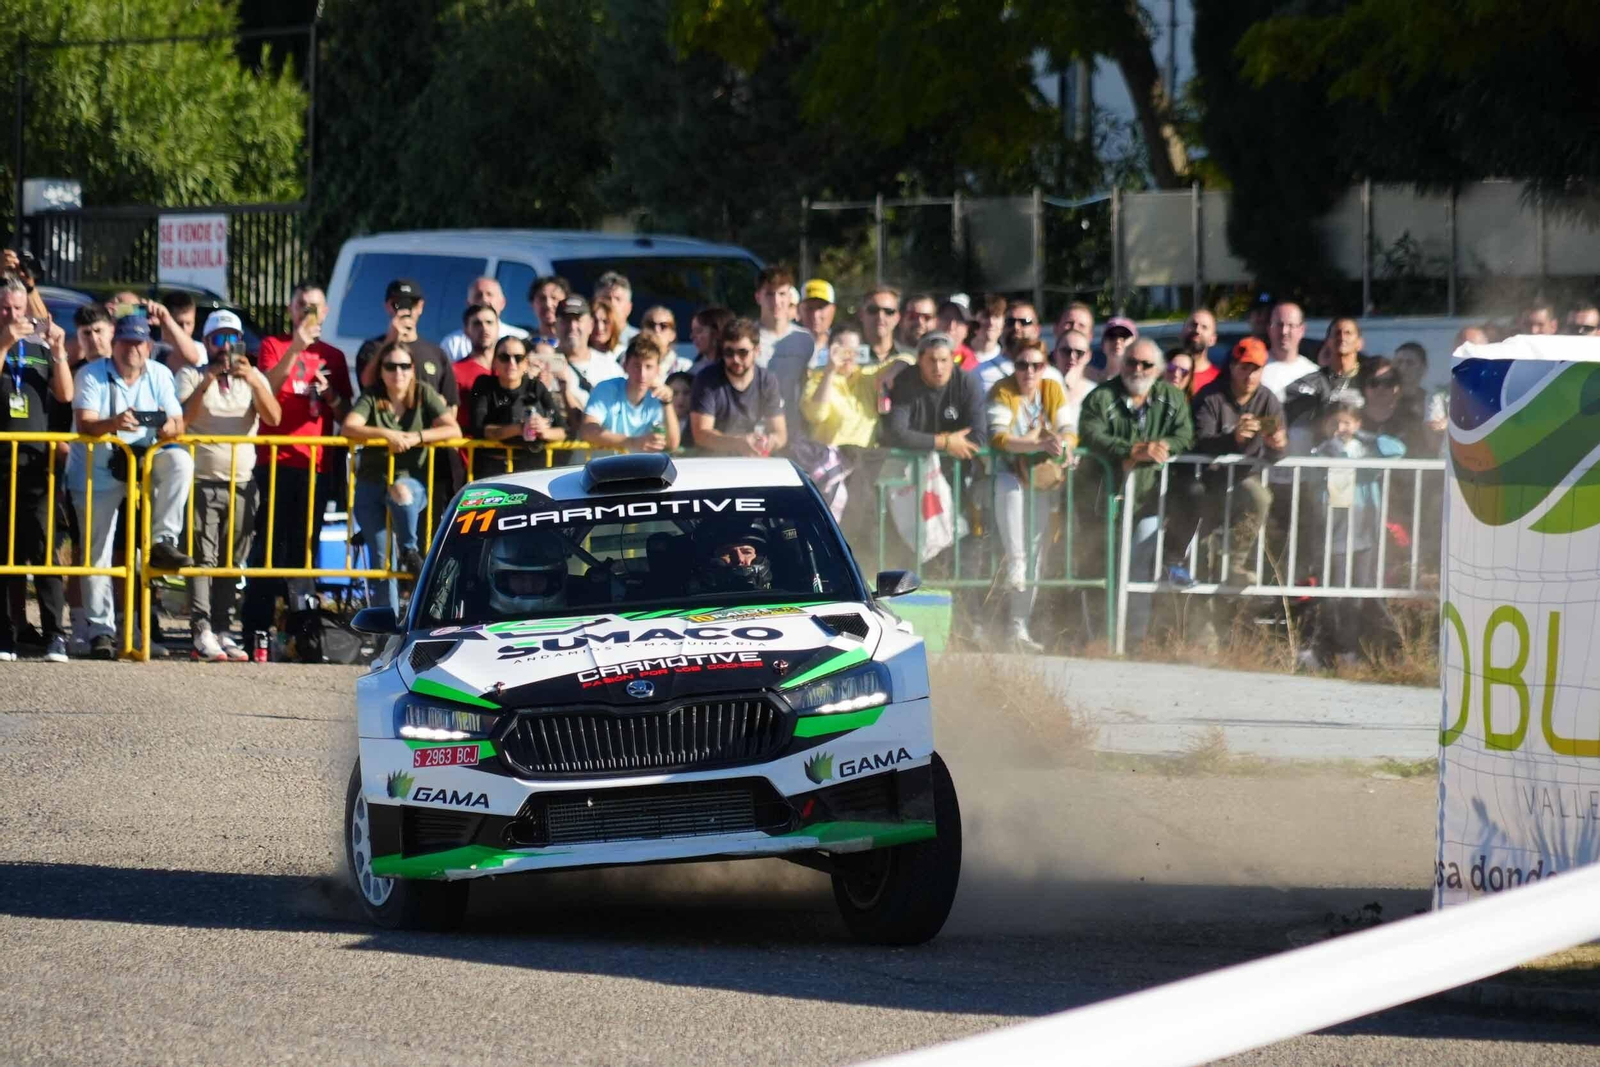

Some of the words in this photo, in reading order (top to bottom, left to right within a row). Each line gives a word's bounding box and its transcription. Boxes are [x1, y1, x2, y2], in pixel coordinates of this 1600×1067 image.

[160, 224, 173, 243] SE
[160, 249, 173, 268] SE
[457, 509, 497, 534] 11
[498, 499, 766, 530] CARMOTIVE
[497, 627, 784, 660] SUMACO
[577, 652, 762, 683] CARMOTIVE
[414, 751, 421, 766] S
[425, 749, 452, 765] 2963
[456, 747, 478, 763] BCJ
[838, 747, 913, 778] GAMA
[412, 787, 490, 809] GAMA
